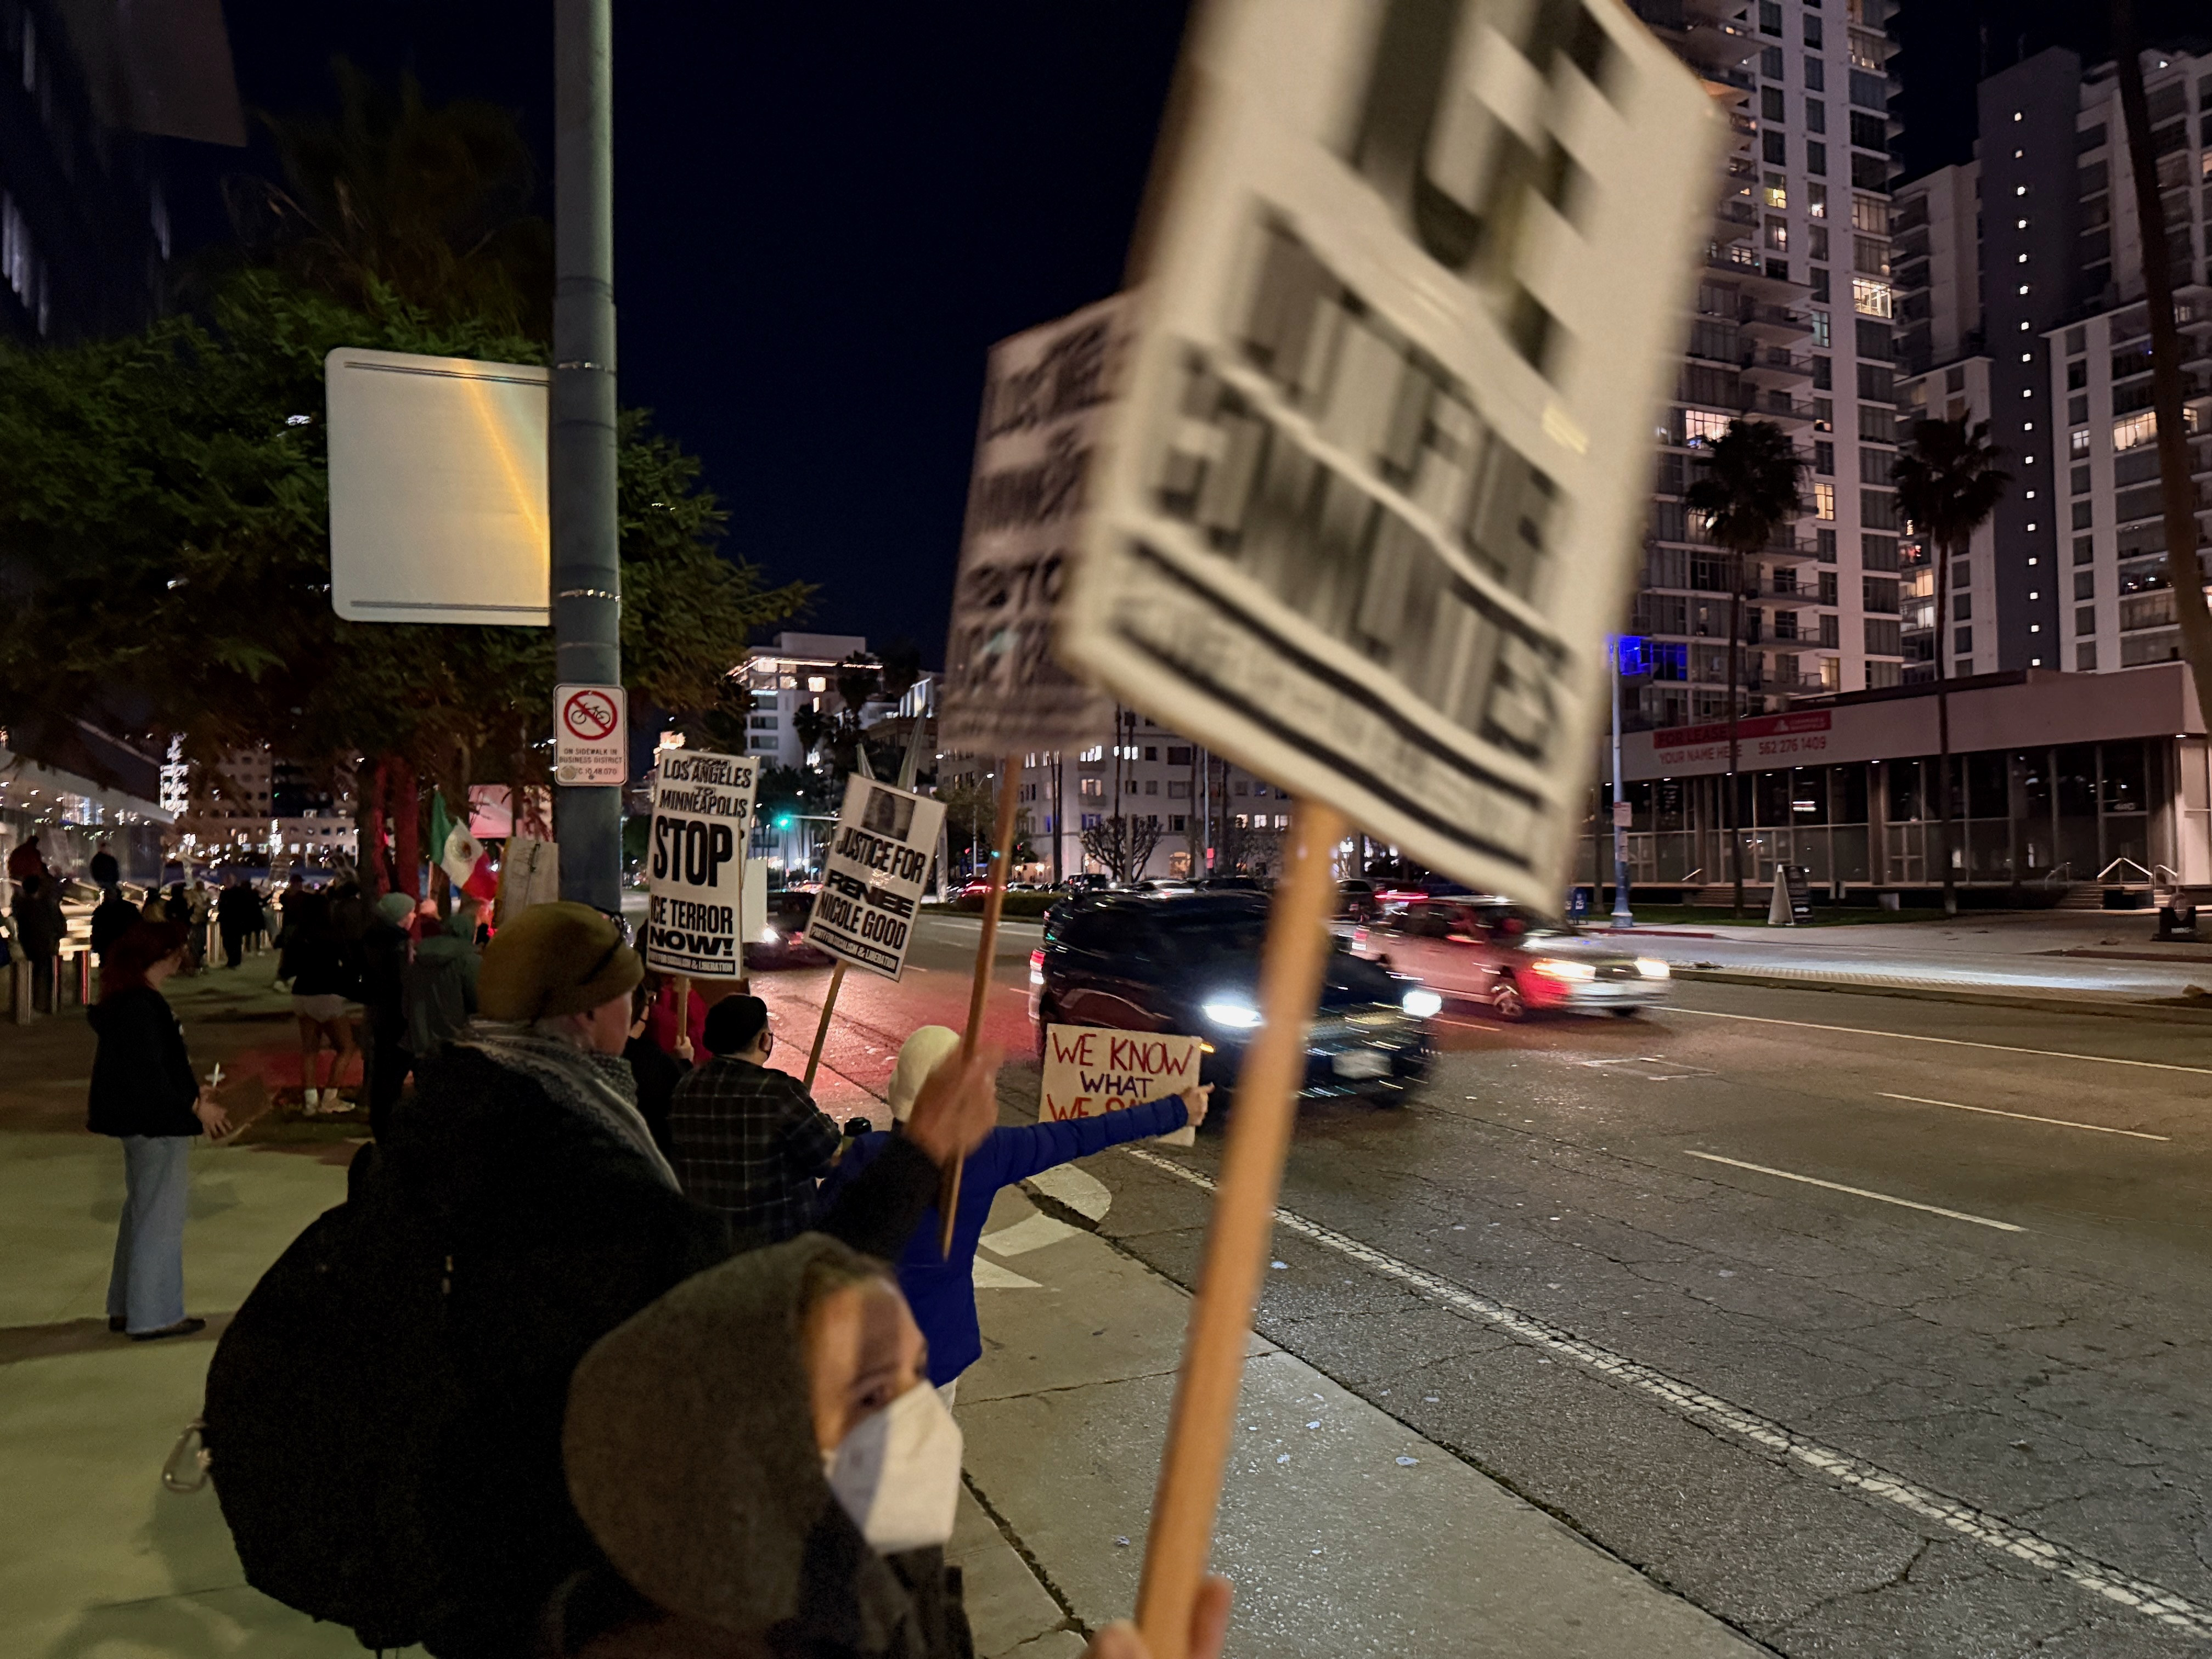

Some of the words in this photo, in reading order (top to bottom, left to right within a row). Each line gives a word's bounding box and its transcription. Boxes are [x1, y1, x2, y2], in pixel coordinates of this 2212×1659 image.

[1686, 726, 1727, 742] LEASE
[1759, 741, 1777, 755] 562
[1780, 738, 1798, 752] 276
[1659, 751, 1684, 764] YOUR
[1687, 748, 1714, 761] NAME
[1717, 744, 1742, 759] HEE
[663, 759, 690, 781] LOS
[691, 761, 752, 788] ANGELES
[659, 788, 748, 819] MINNEAPOLIS
[693, 785, 715, 796] TO
[653, 815, 733, 887] STOP
[834, 826, 894, 874] JUSTICE
[890, 845, 927, 884] FOR
[825, 869, 915, 919] RENEE
[650, 894, 668, 925] ICE
[670, 899, 733, 934] TERROR
[815, 891, 864, 934] NICOLE
[861, 910, 908, 950] GOOD
[649, 926, 735, 957] NOW!
[1053, 1032, 1096, 1066] WE
[1110, 1036, 1193, 1076] KNOW
[1080, 1070, 1153, 1098] WHAT
[1047, 1093, 1092, 1122] WE
